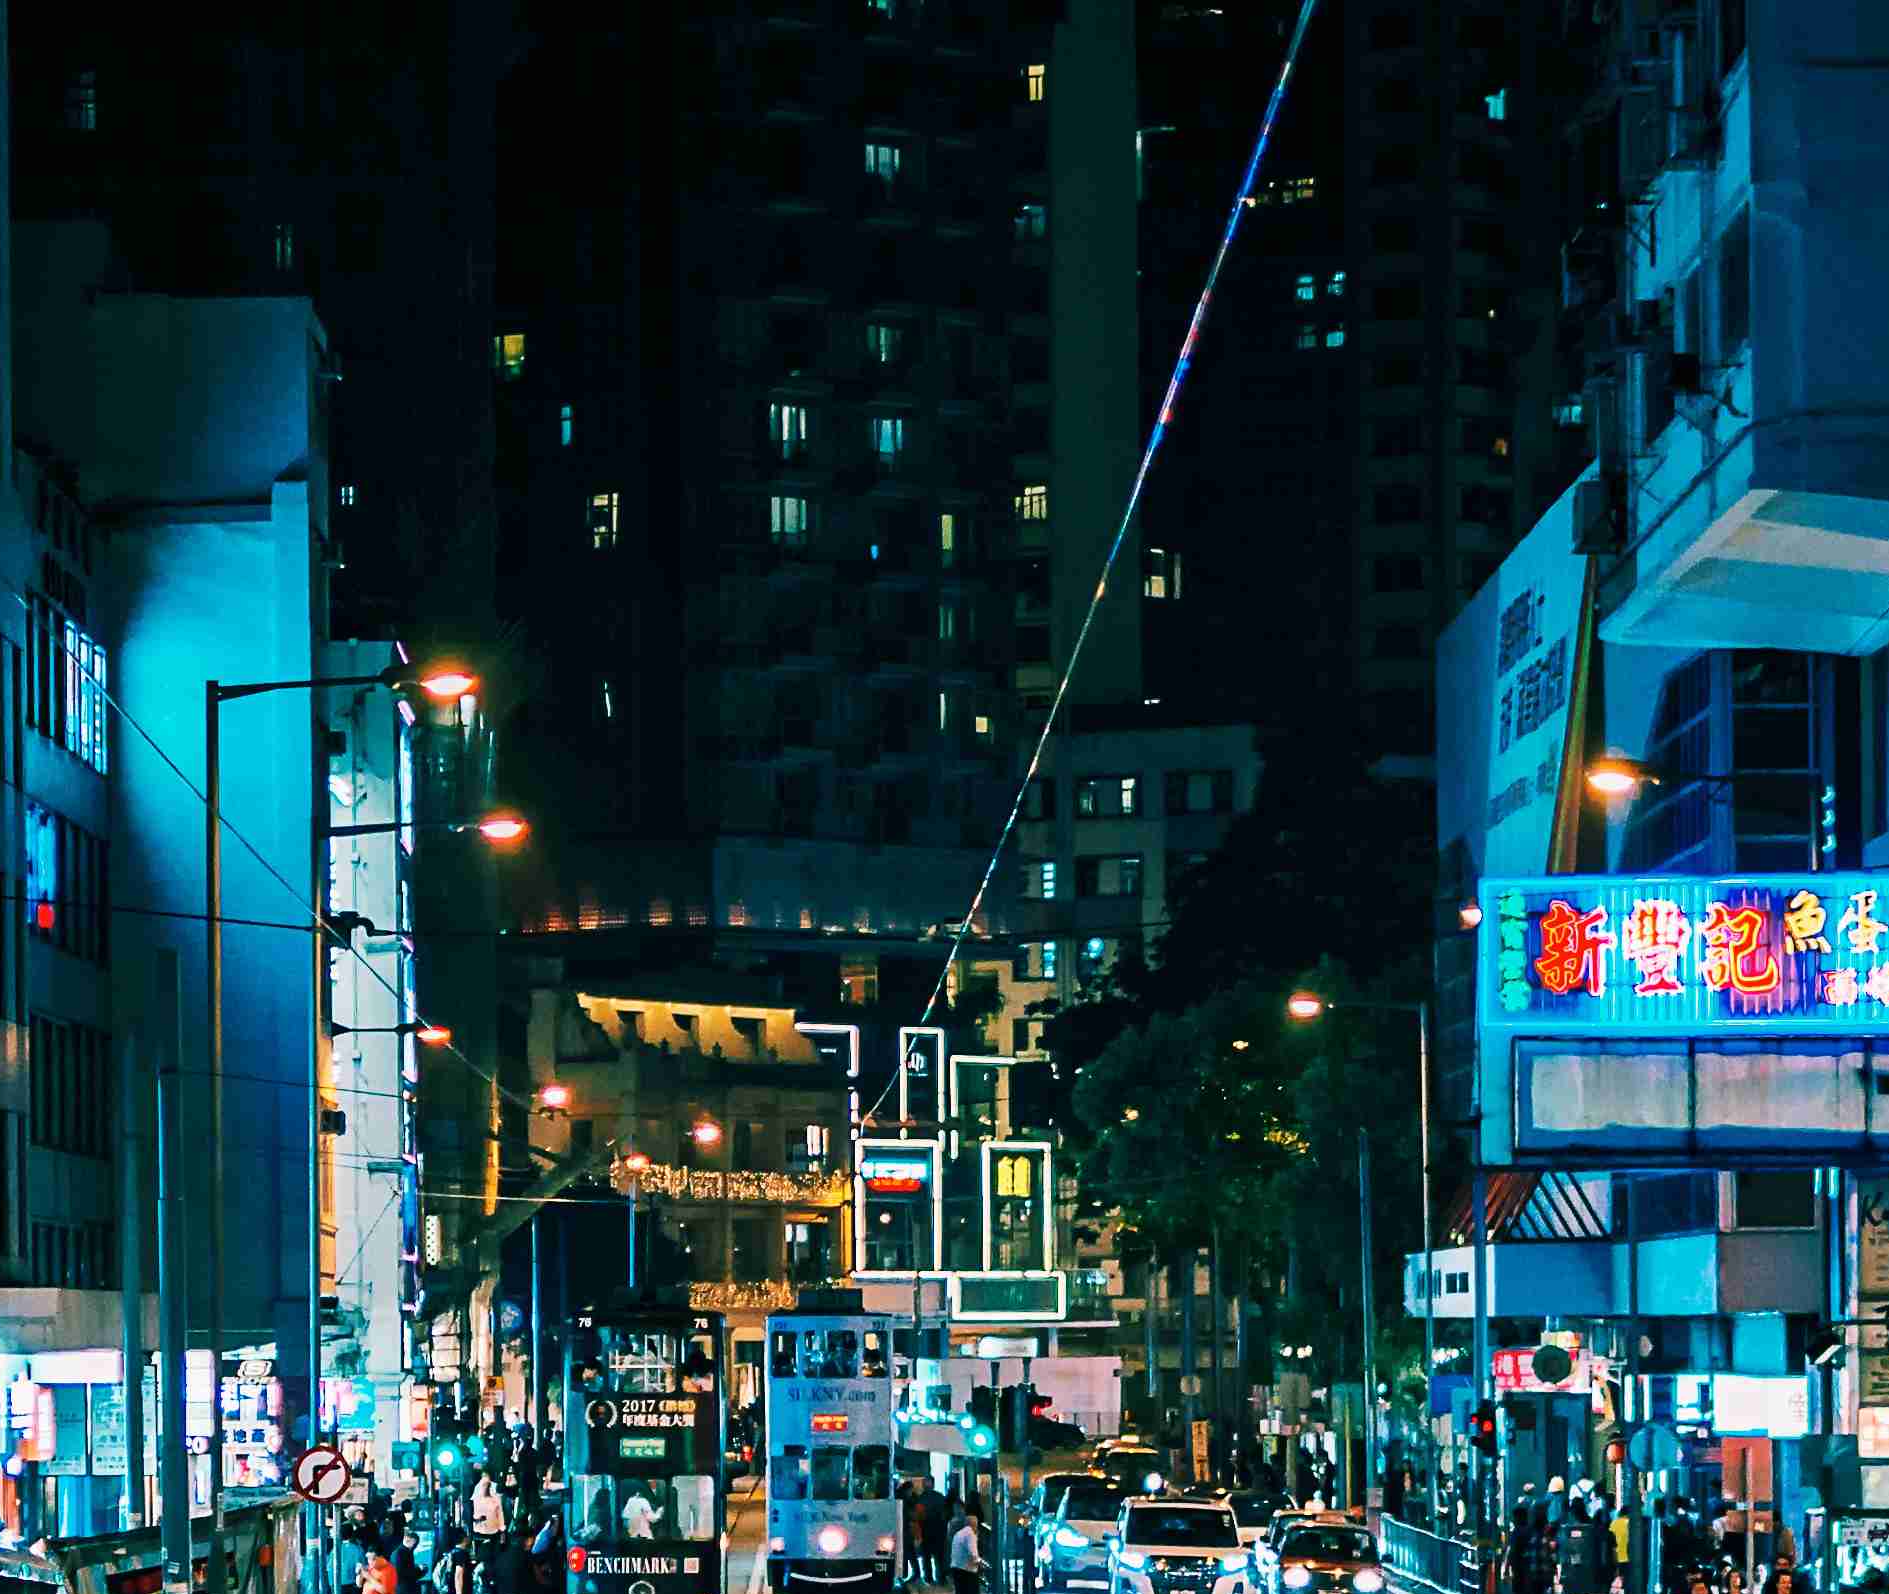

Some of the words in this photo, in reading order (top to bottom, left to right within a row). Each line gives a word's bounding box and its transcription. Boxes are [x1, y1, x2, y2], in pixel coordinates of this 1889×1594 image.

[1535, 898, 1782, 999] 新豐記
[587, 1557, 671, 1574] BENCHMARK
